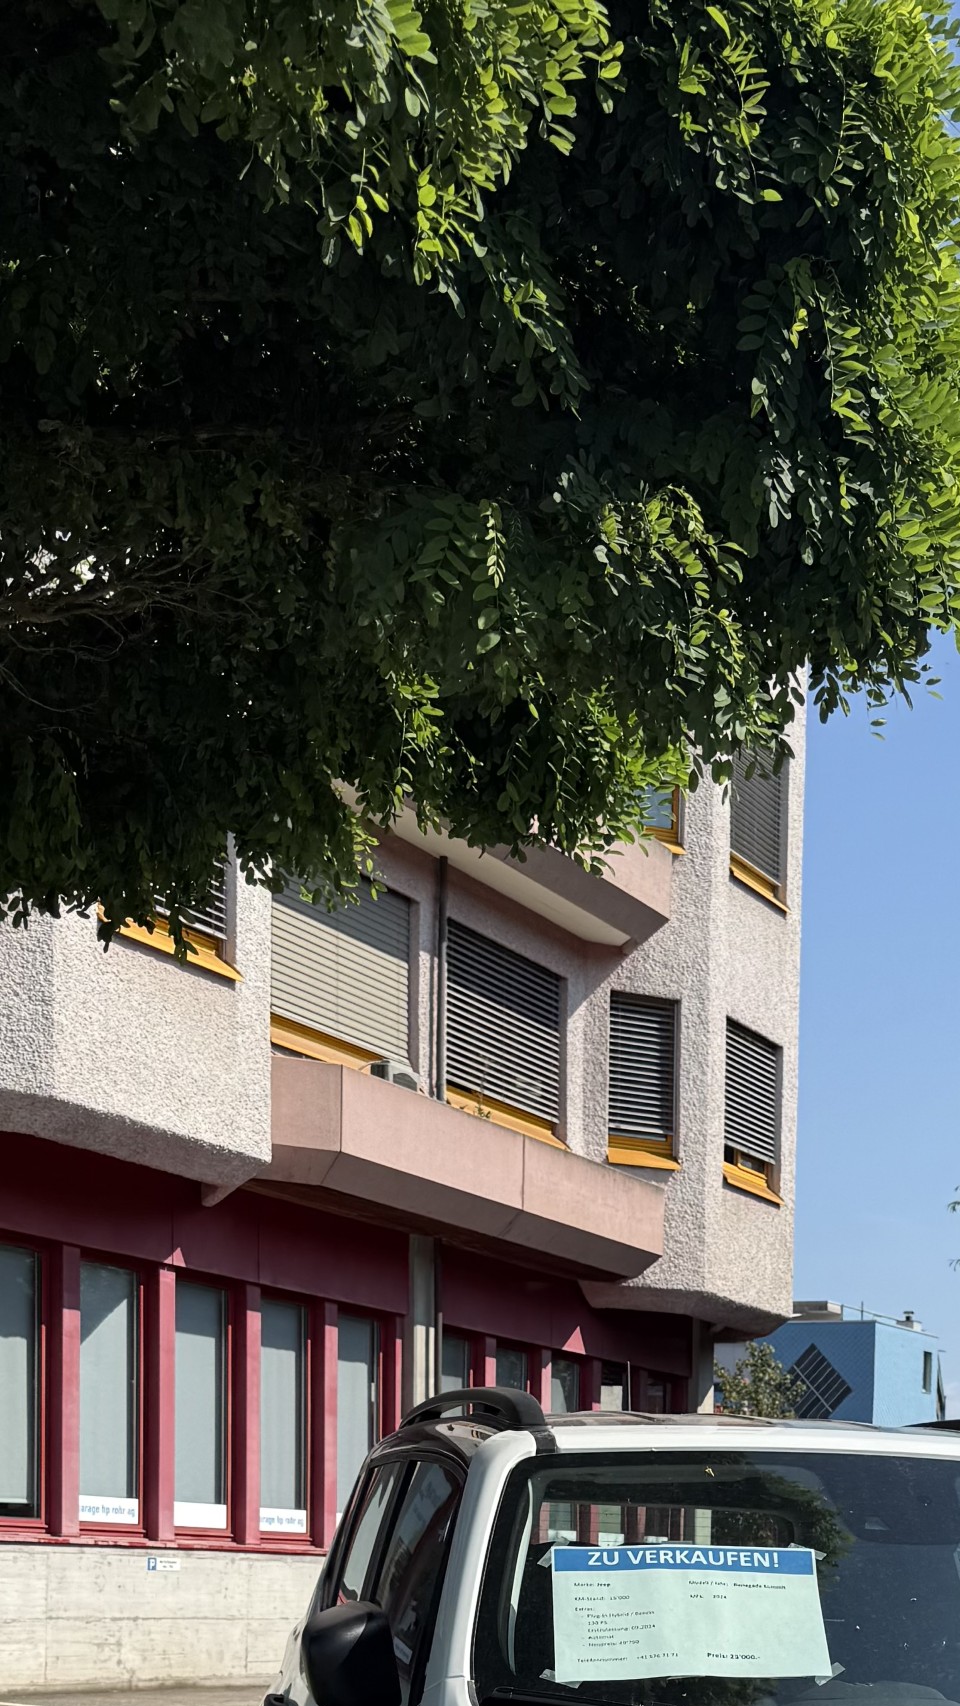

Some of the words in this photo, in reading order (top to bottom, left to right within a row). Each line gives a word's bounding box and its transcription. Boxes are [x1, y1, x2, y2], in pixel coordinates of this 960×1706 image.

[81, 1505, 100, 1516] arage
[587, 1550, 620, 1567] ZU
[626, 1549, 780, 1569] VERKAUFEN!
[733, 1581, 762, 1589] Renegade
